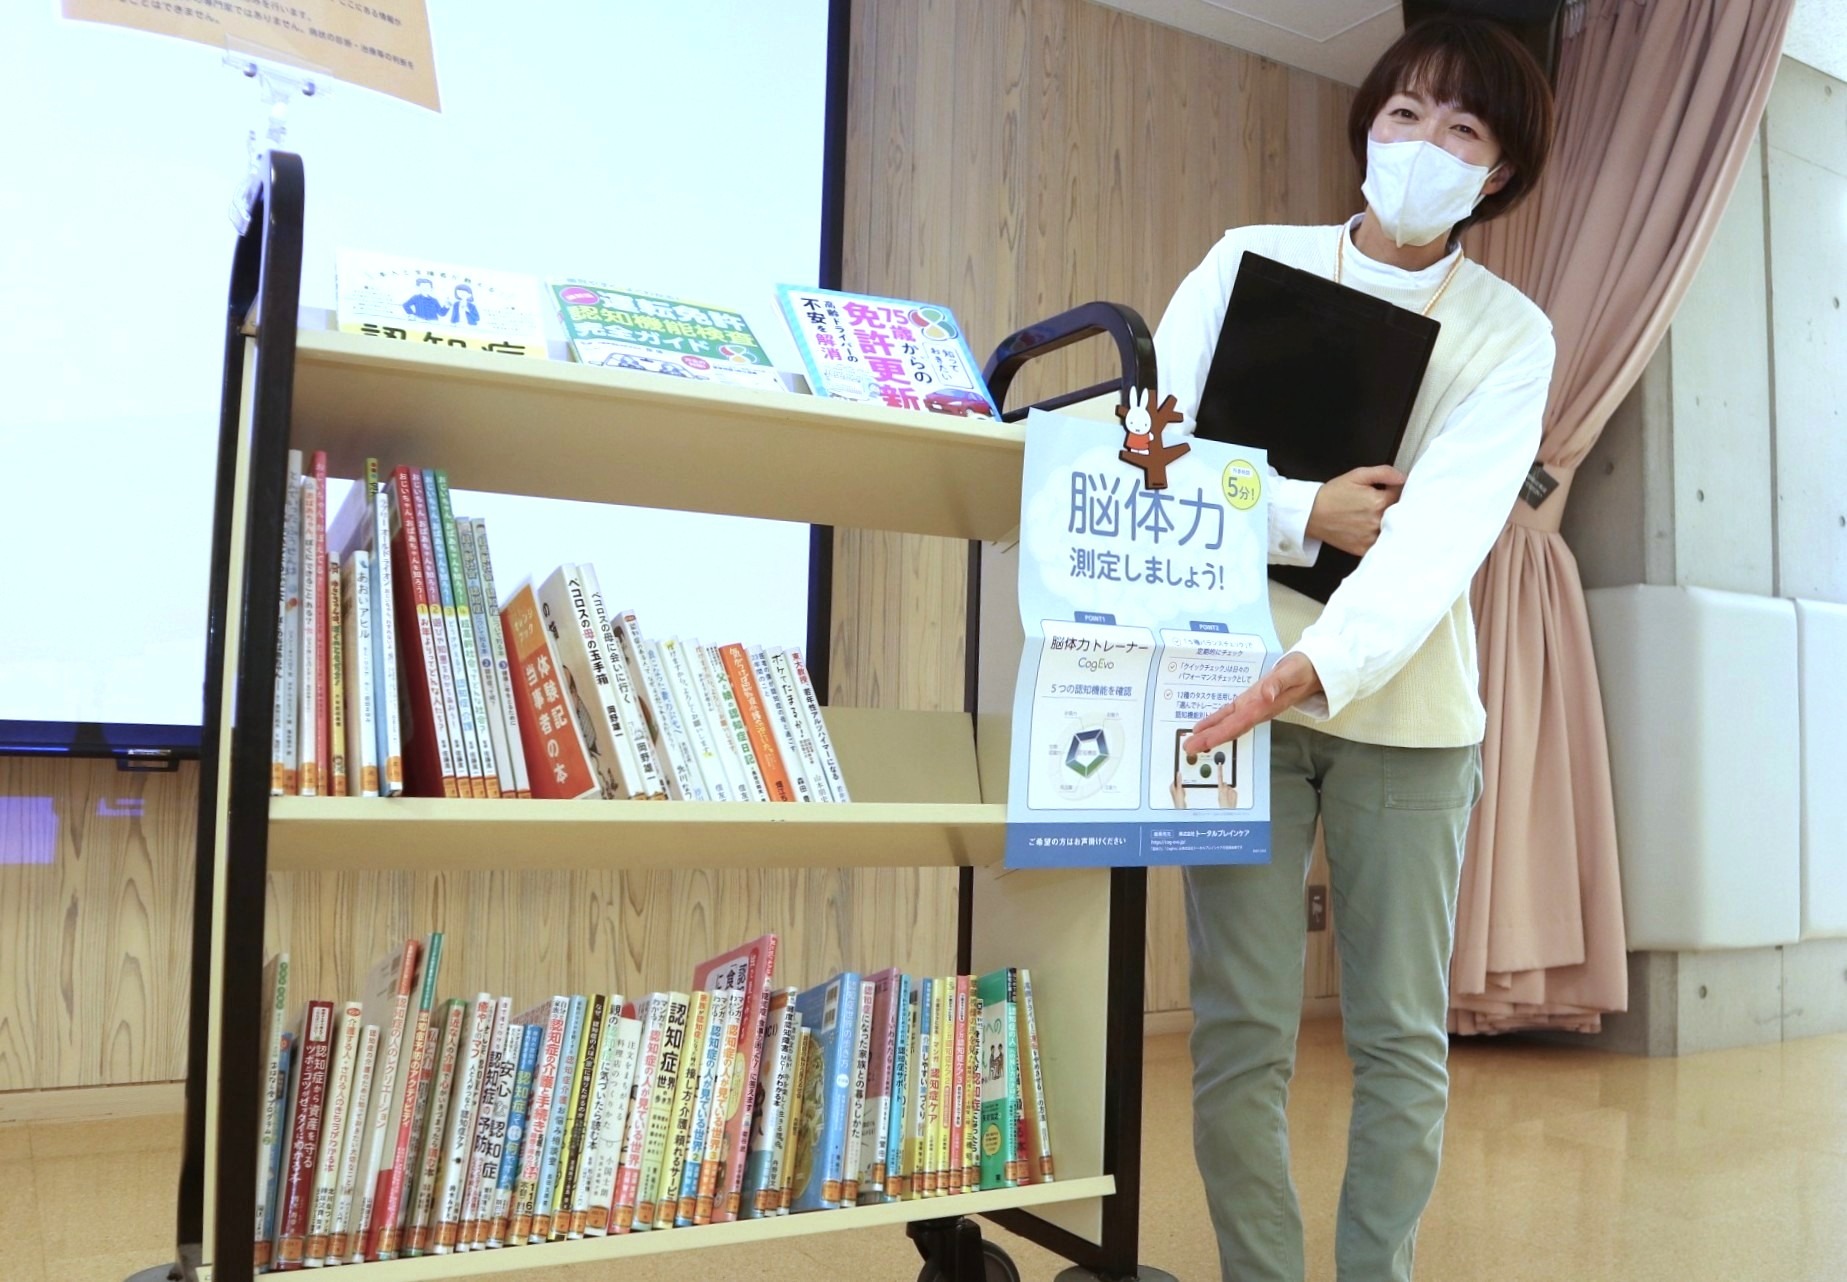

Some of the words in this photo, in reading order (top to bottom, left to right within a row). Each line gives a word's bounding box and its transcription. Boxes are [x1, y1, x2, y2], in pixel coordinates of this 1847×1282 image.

[800, 297, 843, 361] 不安を解消
[842, 301, 920, 411] 免許更新
[876, 307, 933, 384] 75歳からの
[1068, 471, 1224, 550] 脳体力
[1050, 635, 1149, 653] 脳体力トレーナー
[1078, 657, 1114, 672] CogEvo
[536, 653, 568, 730] 体験記
[304, 1045, 327, 1168] 認知症から資産を守る
[475, 1051, 502, 1153] 認知症の予防
[630, 1030, 661, 1167] 認知症の人が見ている世界
[667, 1068, 697, 1200] 接し方・介護・頼れるサービ
[928, 1068, 940, 1123] 認知症ケア
